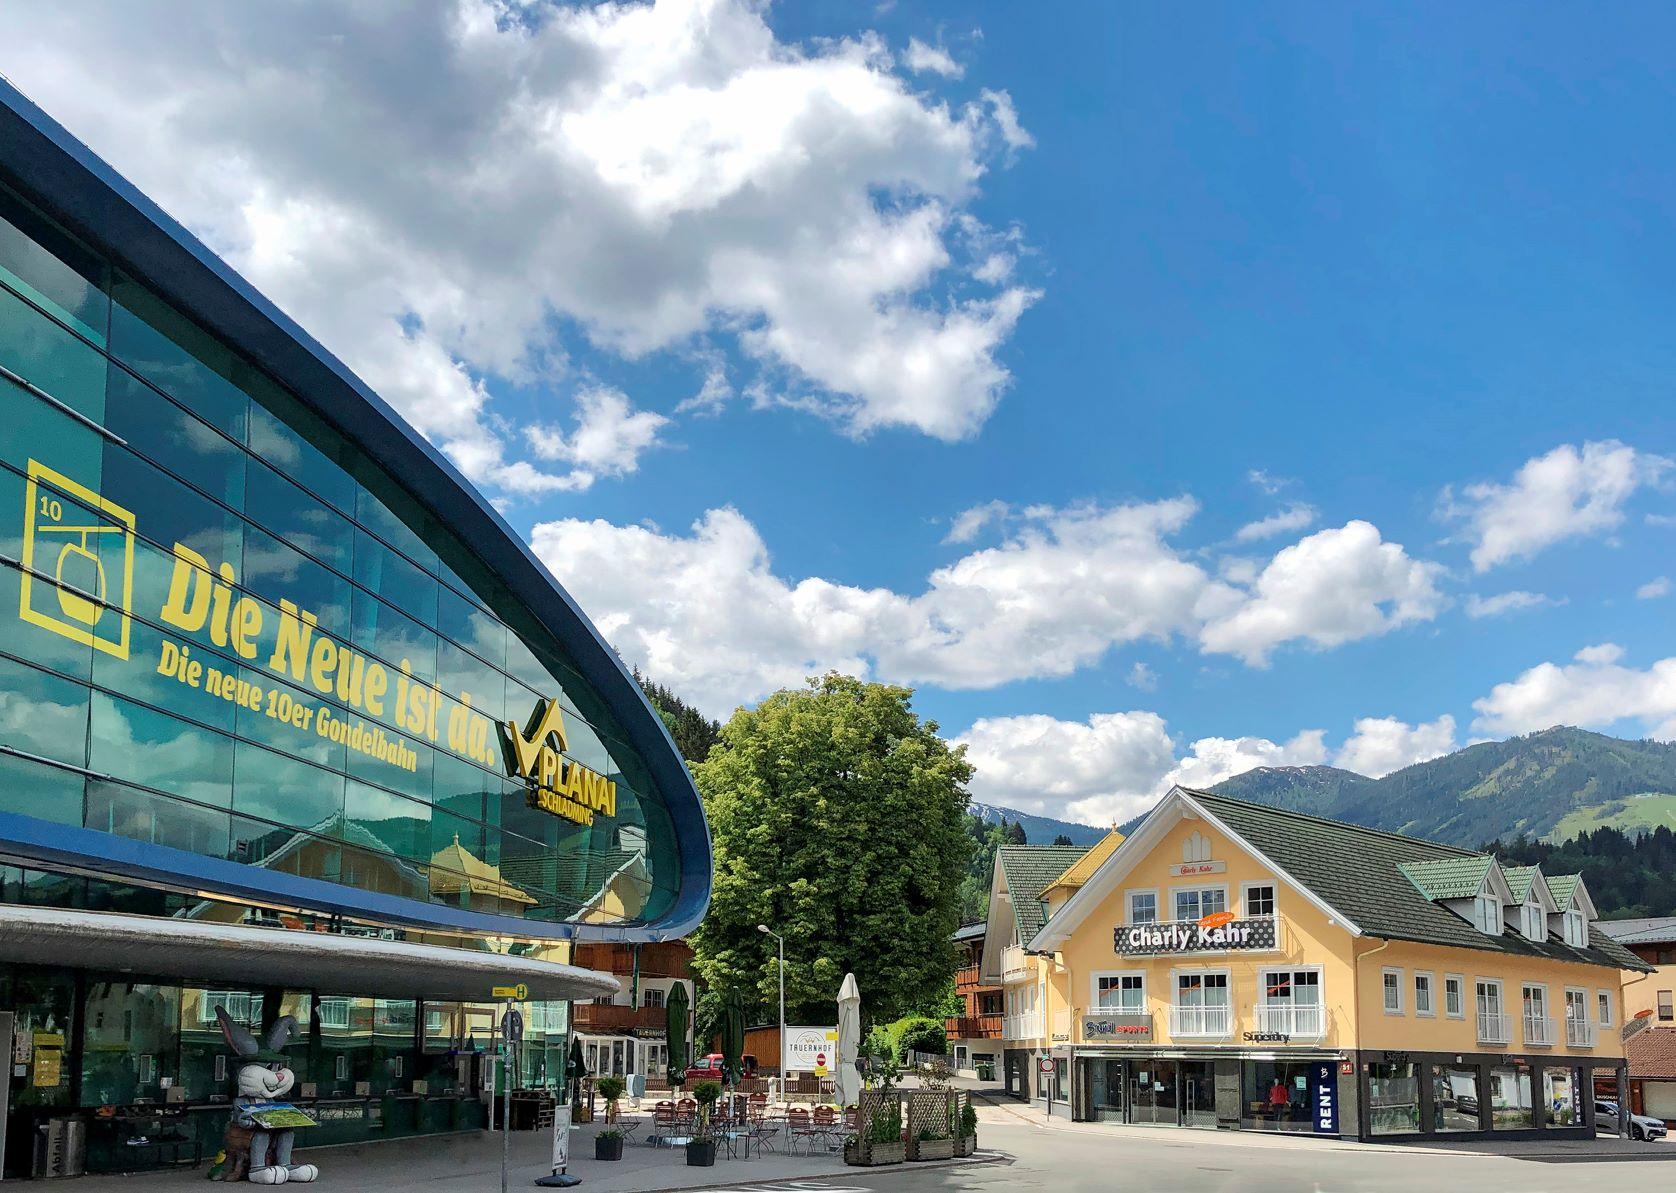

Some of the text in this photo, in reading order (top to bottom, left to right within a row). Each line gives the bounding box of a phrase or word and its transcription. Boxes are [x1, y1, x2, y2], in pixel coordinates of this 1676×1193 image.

[40, 495, 62, 522] 10
[160, 541, 495, 767] Die Neue ist da.
[157, 639, 417, 773] Die neue 10er Gondelbahn
[538, 745, 616, 817] PLANAI
[538, 788, 594, 827] SCHLADMING
[1128, 923, 1251, 950] Charly Kahr
[516, 985, 525, 998] H
[789, 1043, 832, 1052] TAUERNHOF
[1319, 1084, 1332, 1129] RENT
[52, 1137, 61, 1172] Abfall
